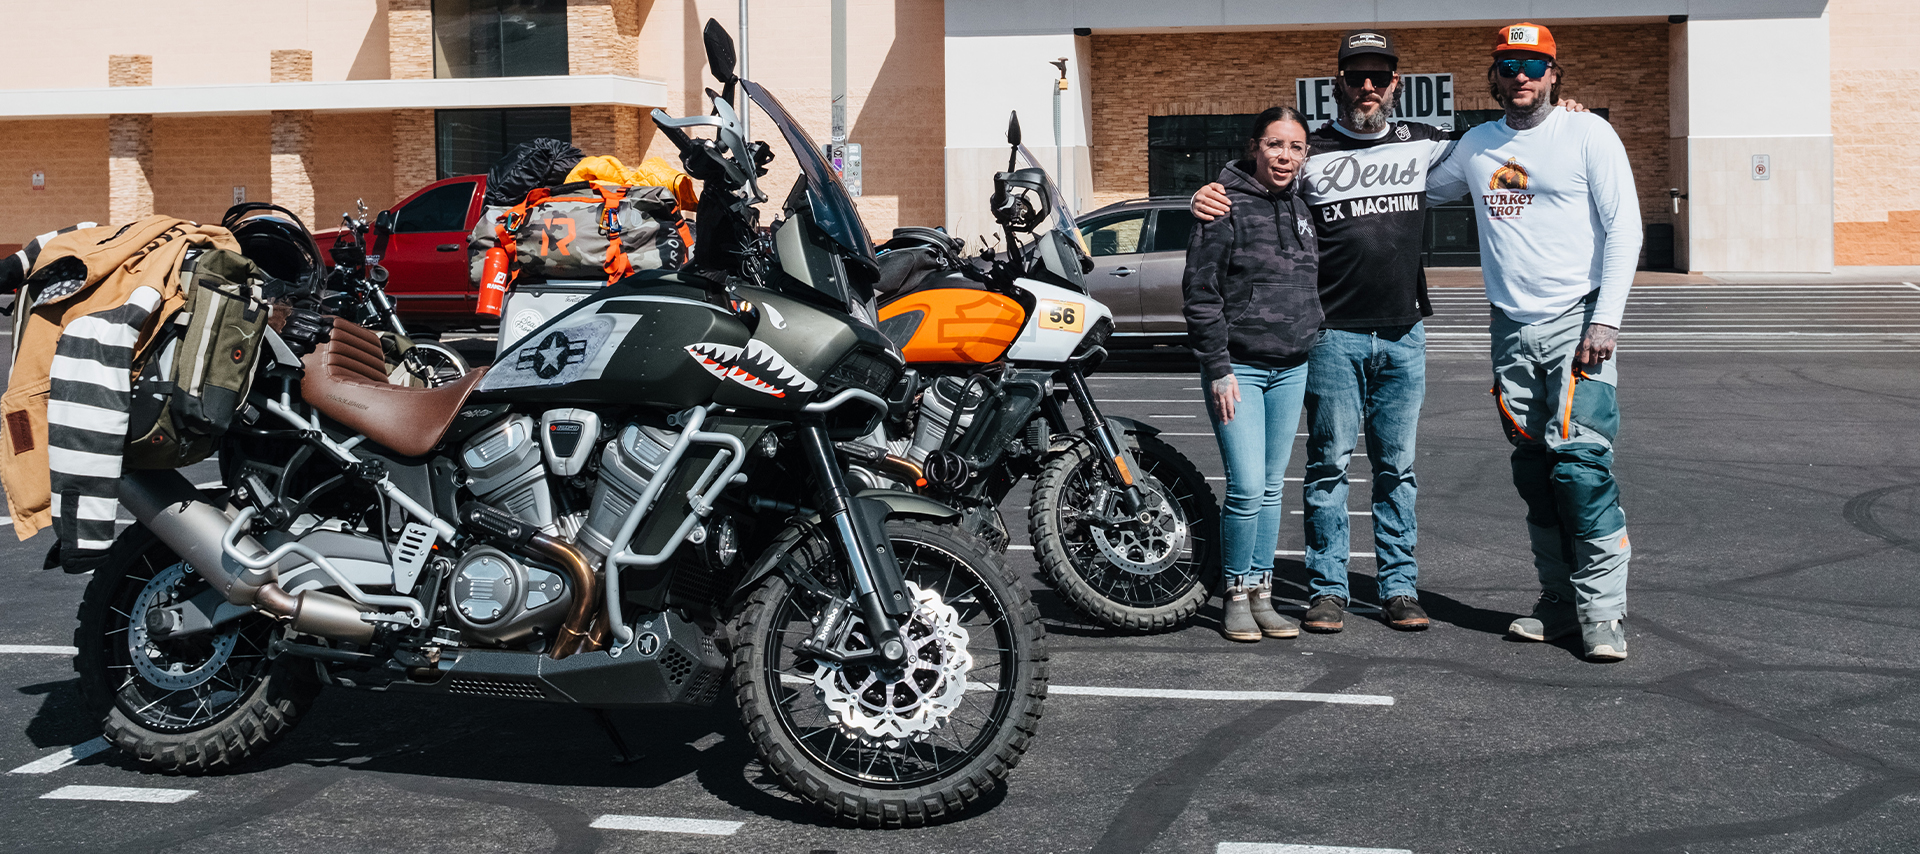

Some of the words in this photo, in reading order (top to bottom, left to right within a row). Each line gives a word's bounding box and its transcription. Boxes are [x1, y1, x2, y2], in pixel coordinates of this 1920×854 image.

[1511, 31, 1523, 41] 100
[1389, 75, 1452, 118] IDE
[1316, 153, 1420, 196] Deus
[1321, 203, 1345, 223] EX
[1350, 194, 1419, 217] MACHINA
[1482, 194, 1535, 205] TURKEY
[1489, 206, 1524, 216] TROT
[1050, 306, 1075, 325] 56
[818, 607, 839, 640] brembo
